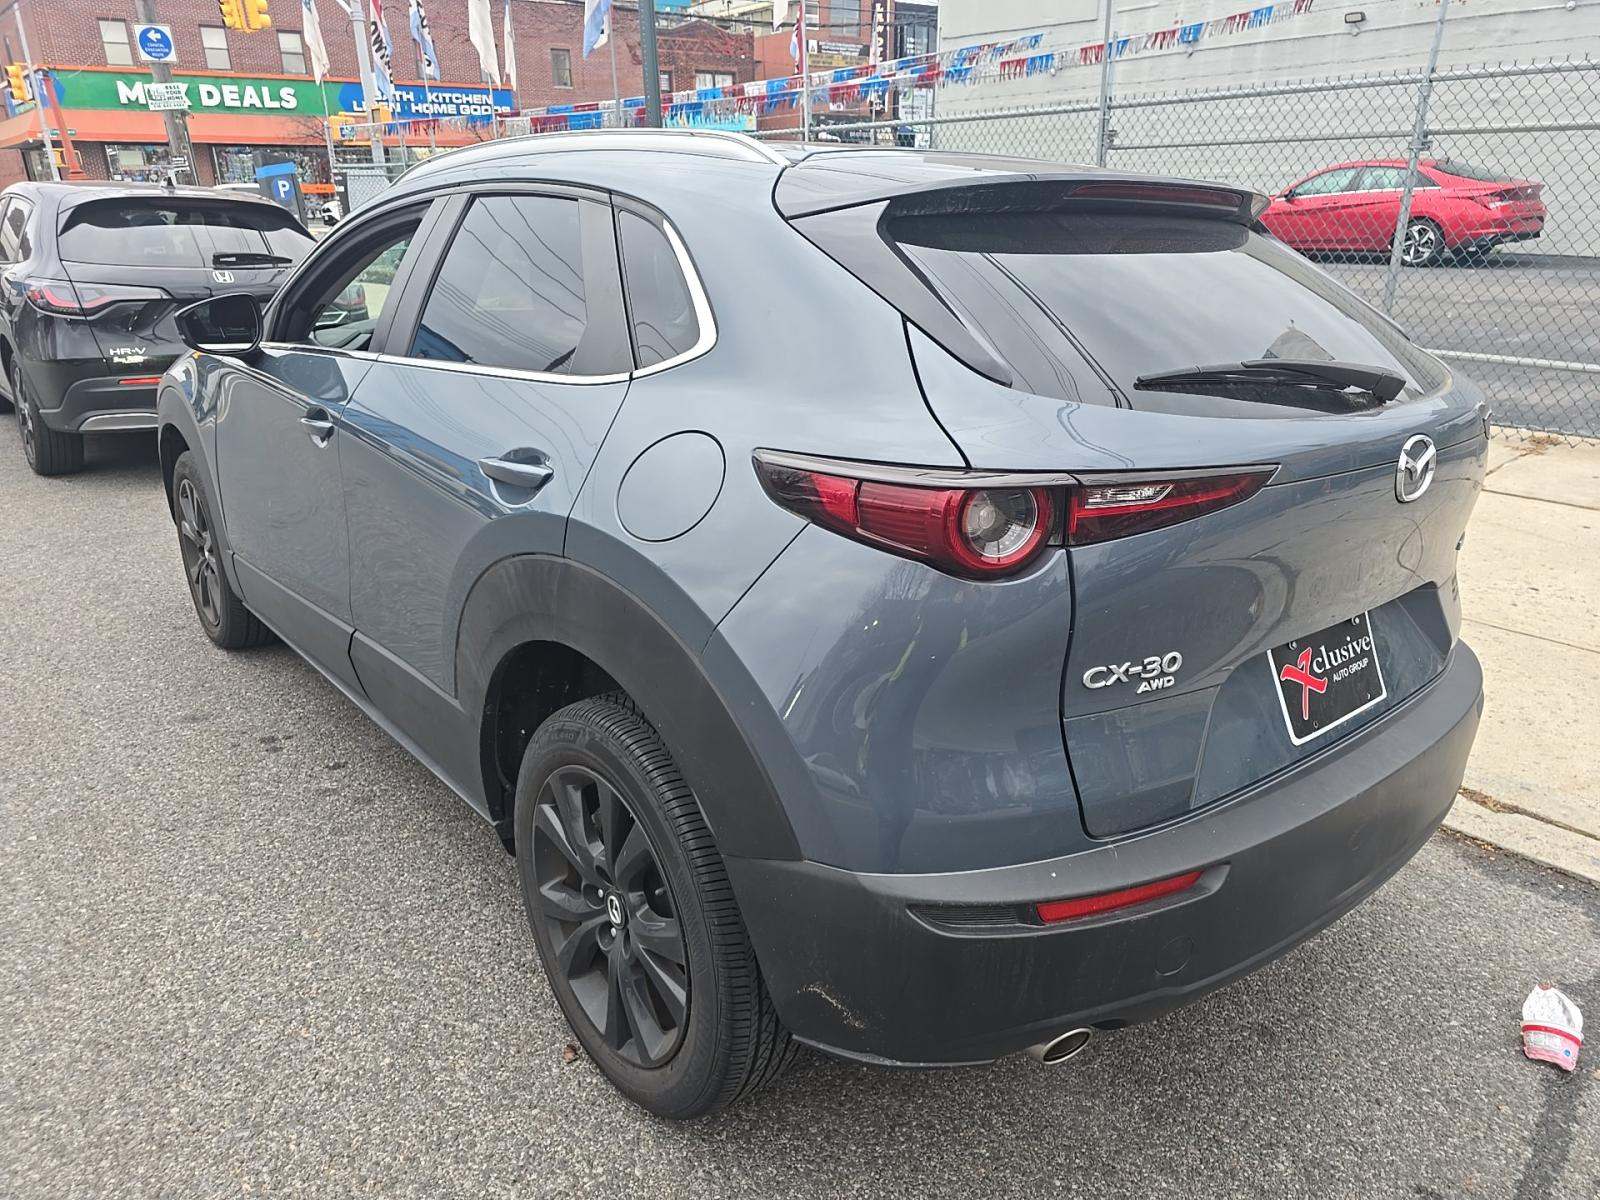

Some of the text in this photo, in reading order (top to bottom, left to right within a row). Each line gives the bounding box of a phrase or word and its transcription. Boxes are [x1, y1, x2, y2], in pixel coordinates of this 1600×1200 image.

[198, 83, 298, 110] DEALS
[428, 93, 493, 105] KITCHEN
[411, 102, 457, 114] HOME
[460, 104, 512, 116] GOODS
[278, 180, 290, 198] P
[109, 347, 146, 355] HR-V
[1083, 651, 1183, 689] CX-30
[1280, 635, 1371, 721] Xclusive
[1332, 657, 1369, 683] AUTO GROUP
[1136, 675, 1175, 694] AWD
